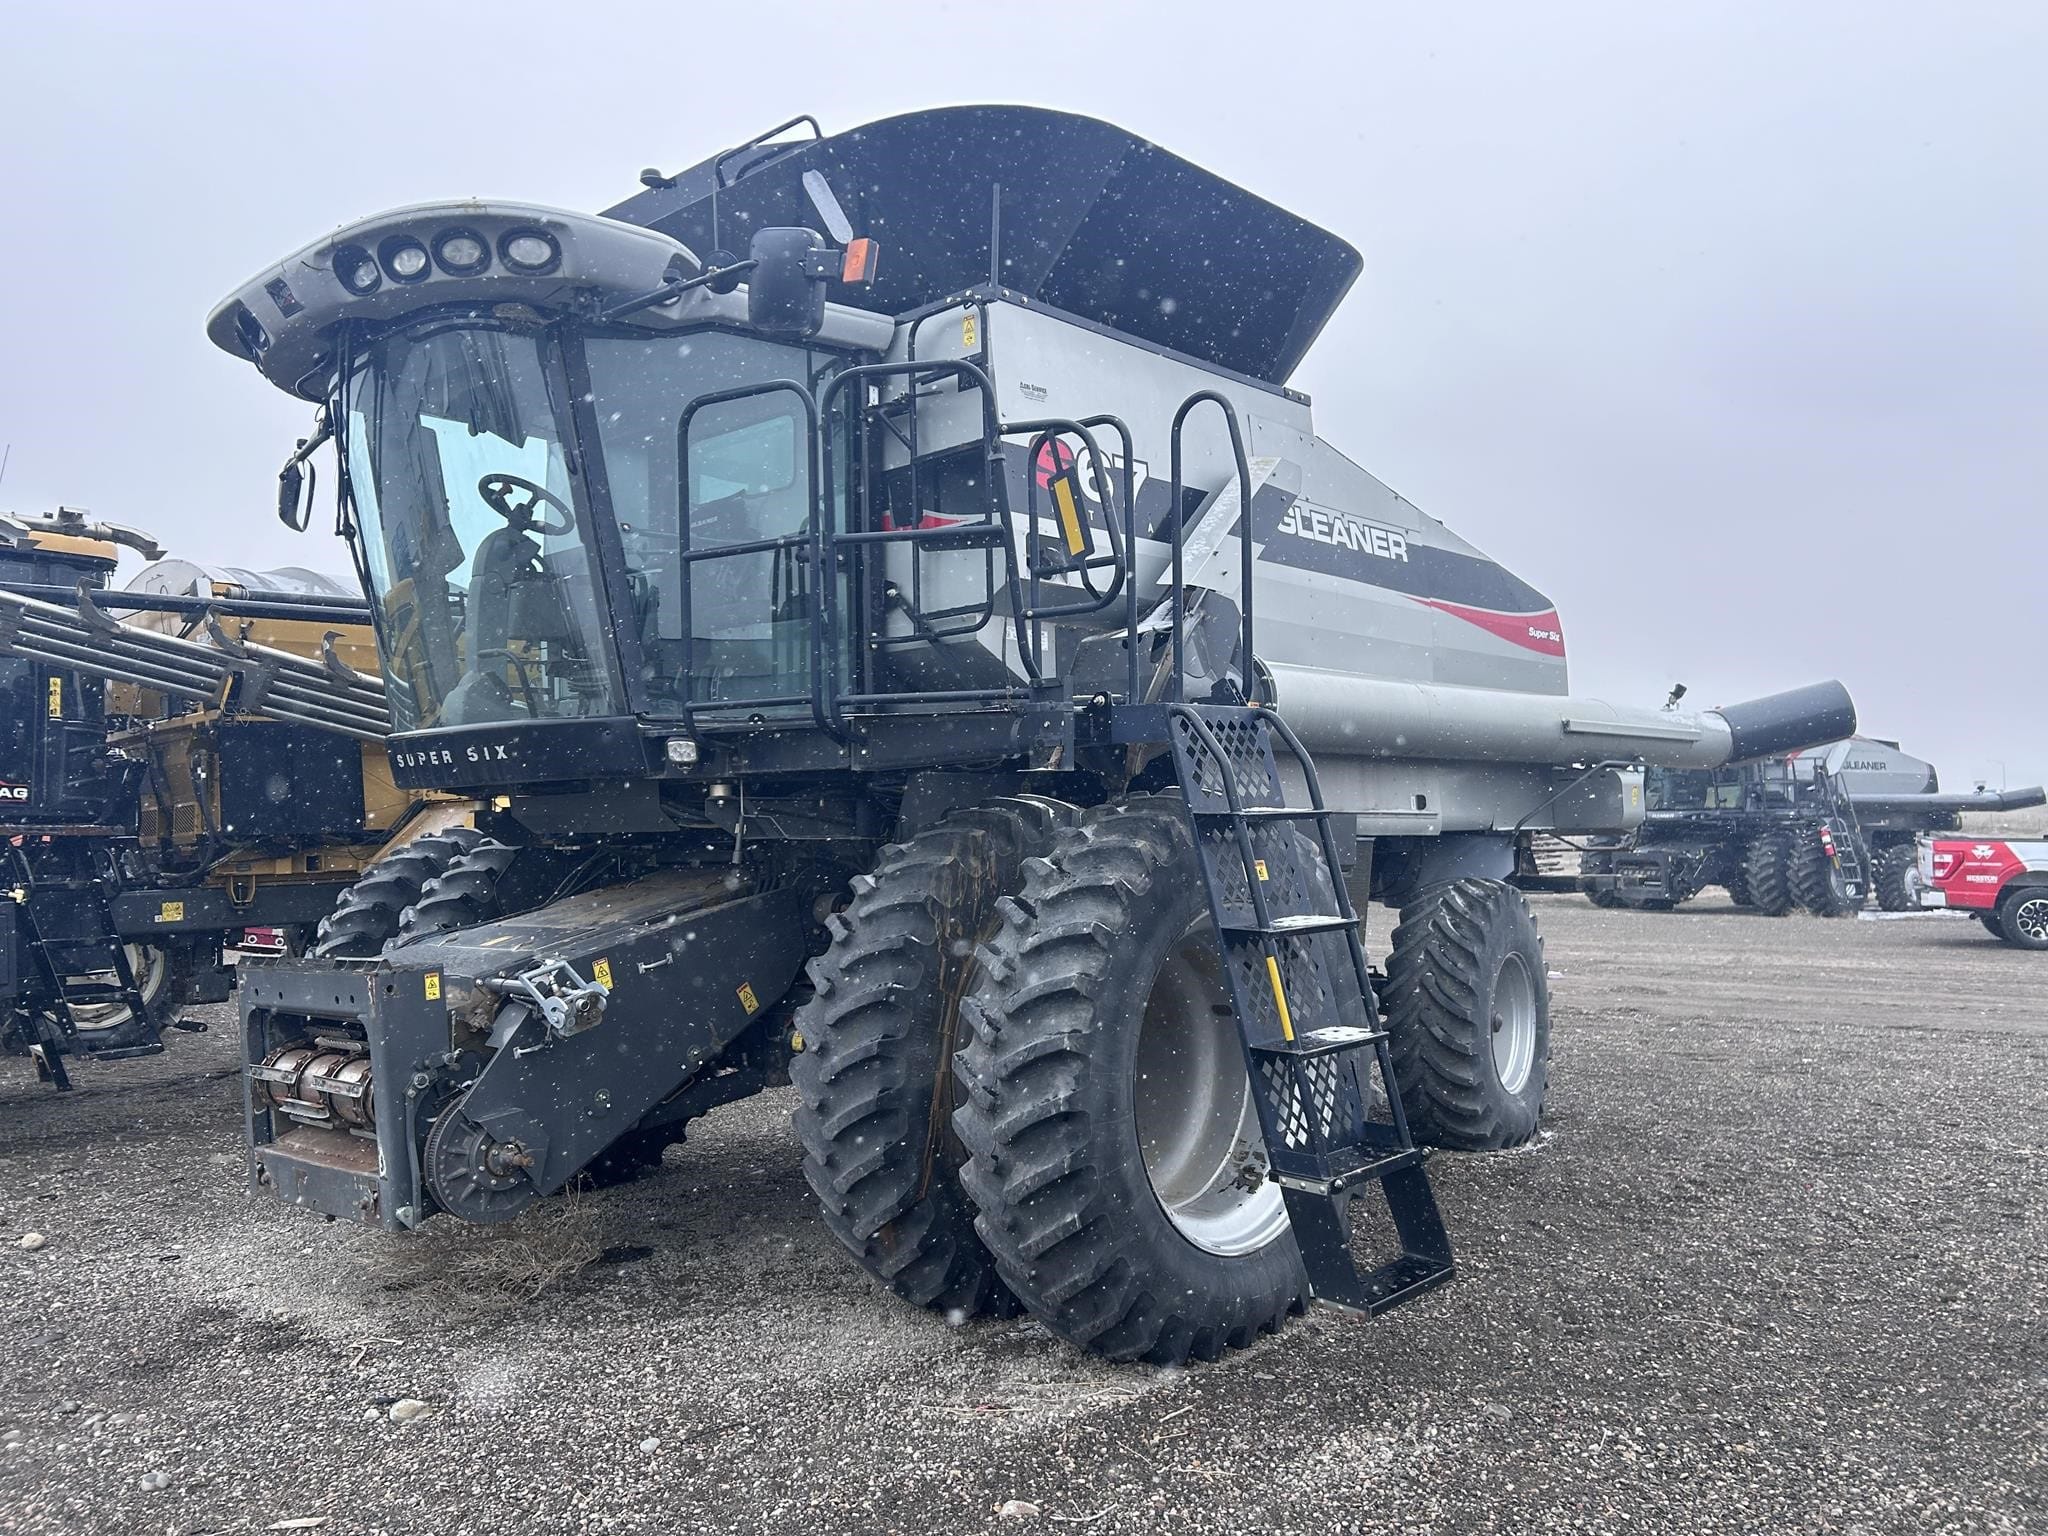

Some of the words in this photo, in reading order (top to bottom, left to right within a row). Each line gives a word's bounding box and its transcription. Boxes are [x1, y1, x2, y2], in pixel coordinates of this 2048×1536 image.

[1528, 626, 1548, 639] Super
[396, 750, 453, 768] SUPER
[466, 745, 509, 762] SIX
